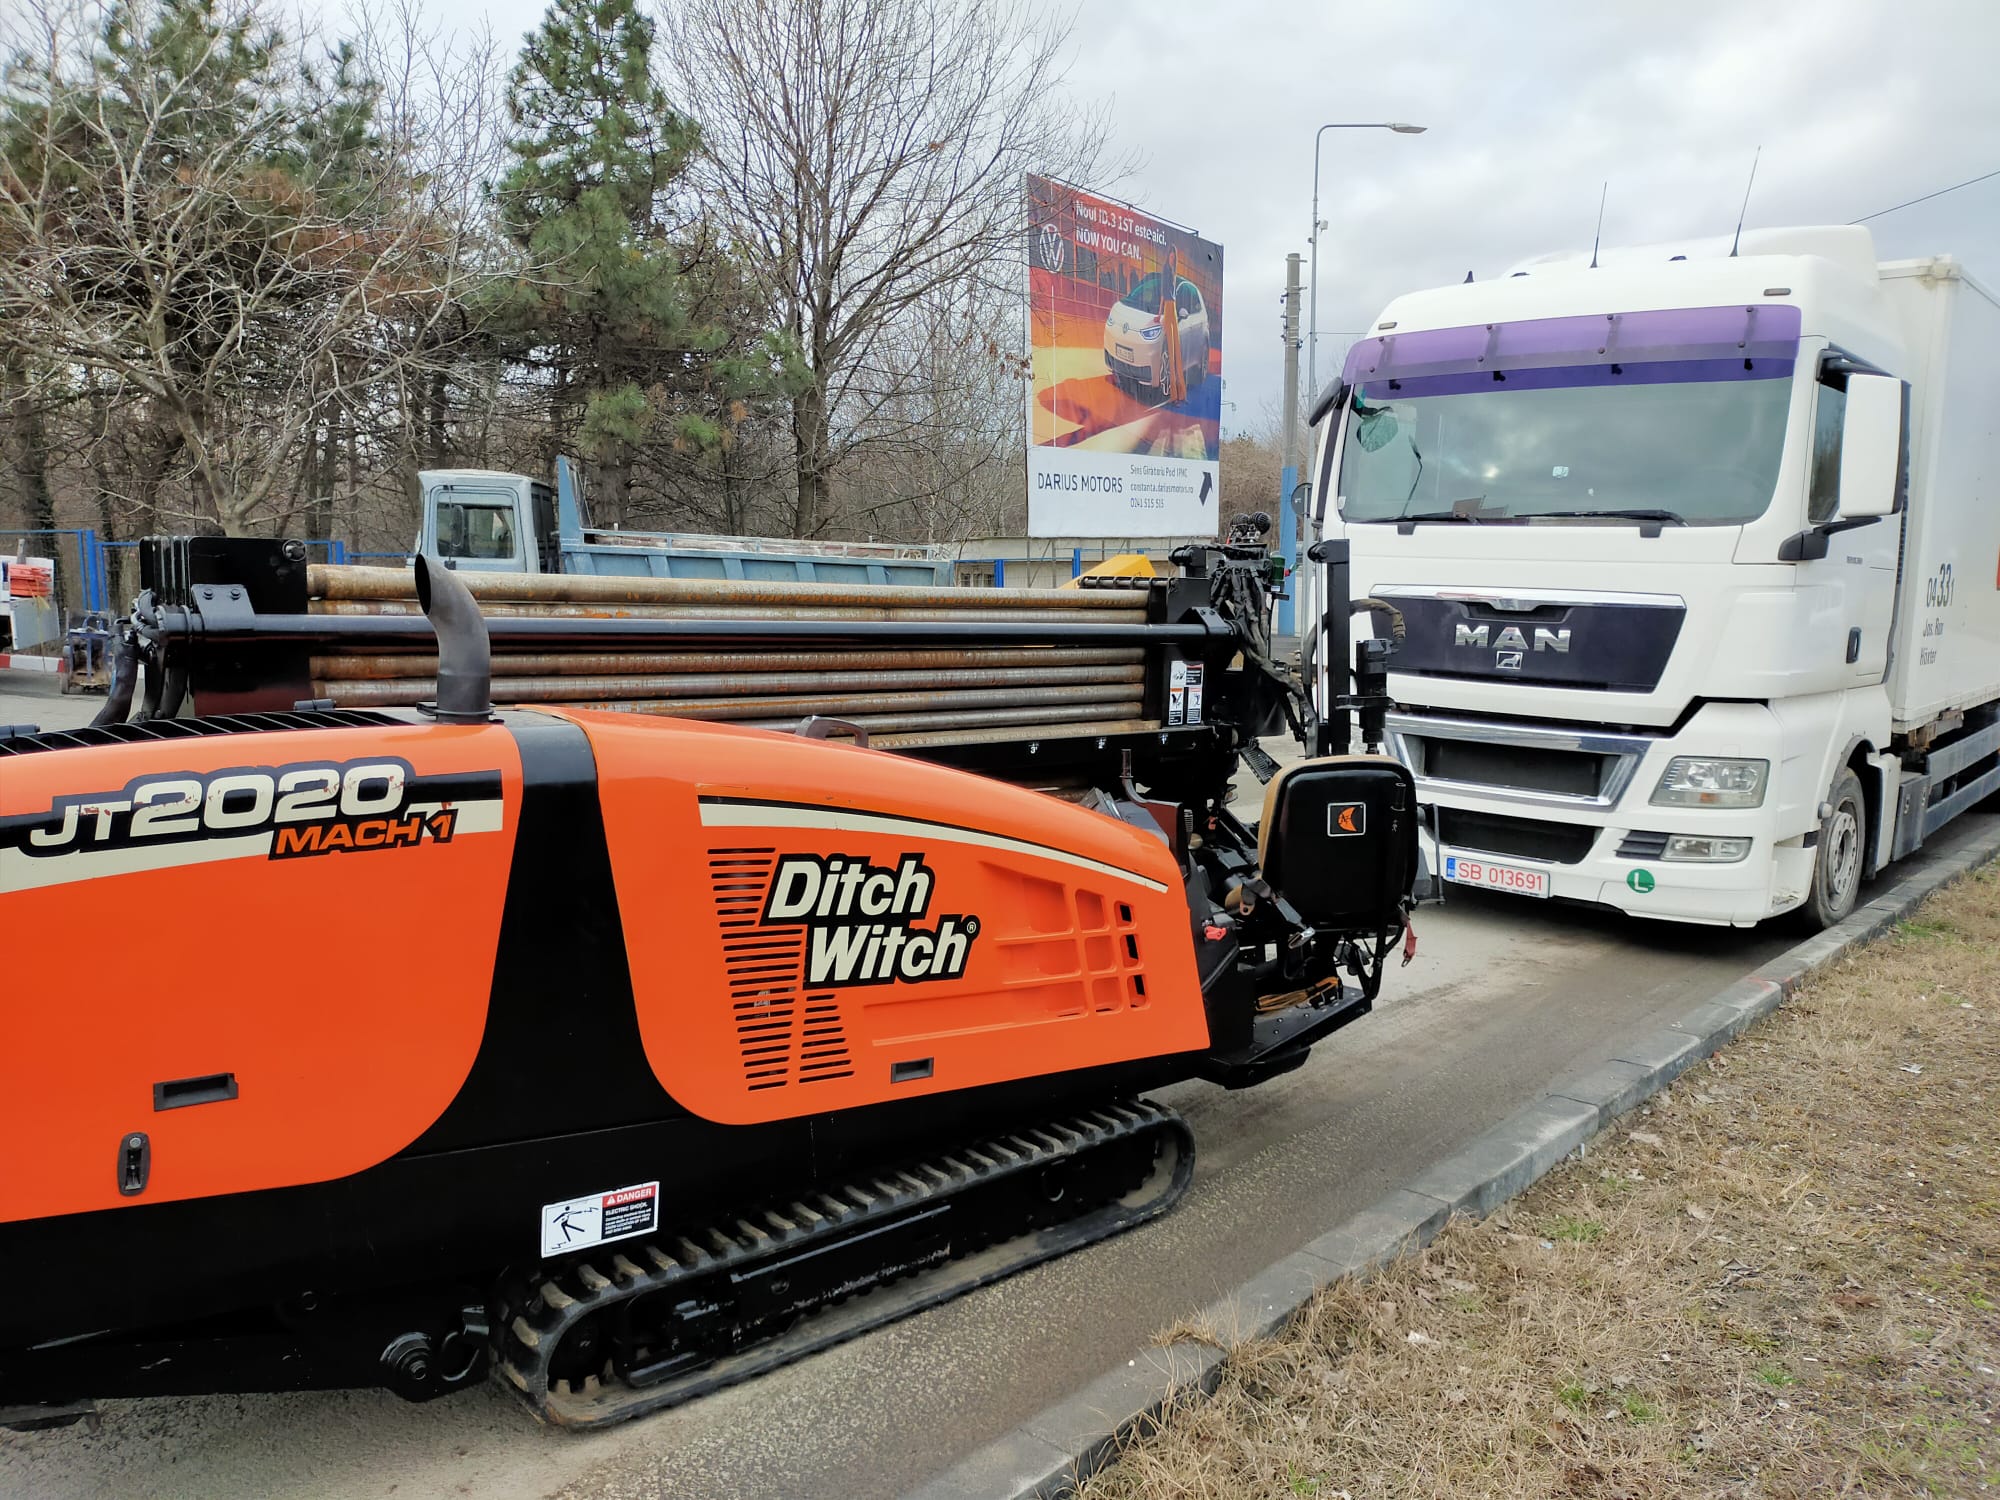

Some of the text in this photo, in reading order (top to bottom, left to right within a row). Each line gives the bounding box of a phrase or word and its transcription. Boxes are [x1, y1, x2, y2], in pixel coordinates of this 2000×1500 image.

[1075, 226, 1142, 261] NOW YOU CAN.
[1118, 215, 1134, 234] 1ST
[1134, 224, 1152, 241] este
[1152, 231, 1167, 247] aici.
[1037, 472, 1123, 494] DARIUS MOTORS
[1455, 624, 1571, 652] MAN
[30, 763, 404, 847] JT2020
[275, 814, 451, 855] MACH 1
[768, 860, 930, 918] Ditch
[1458, 862, 1482, 881] SB
[1489, 867, 1542, 891] 013691
[1633, 871, 1649, 892] L
[616, 1187, 652, 1203] DANGER
